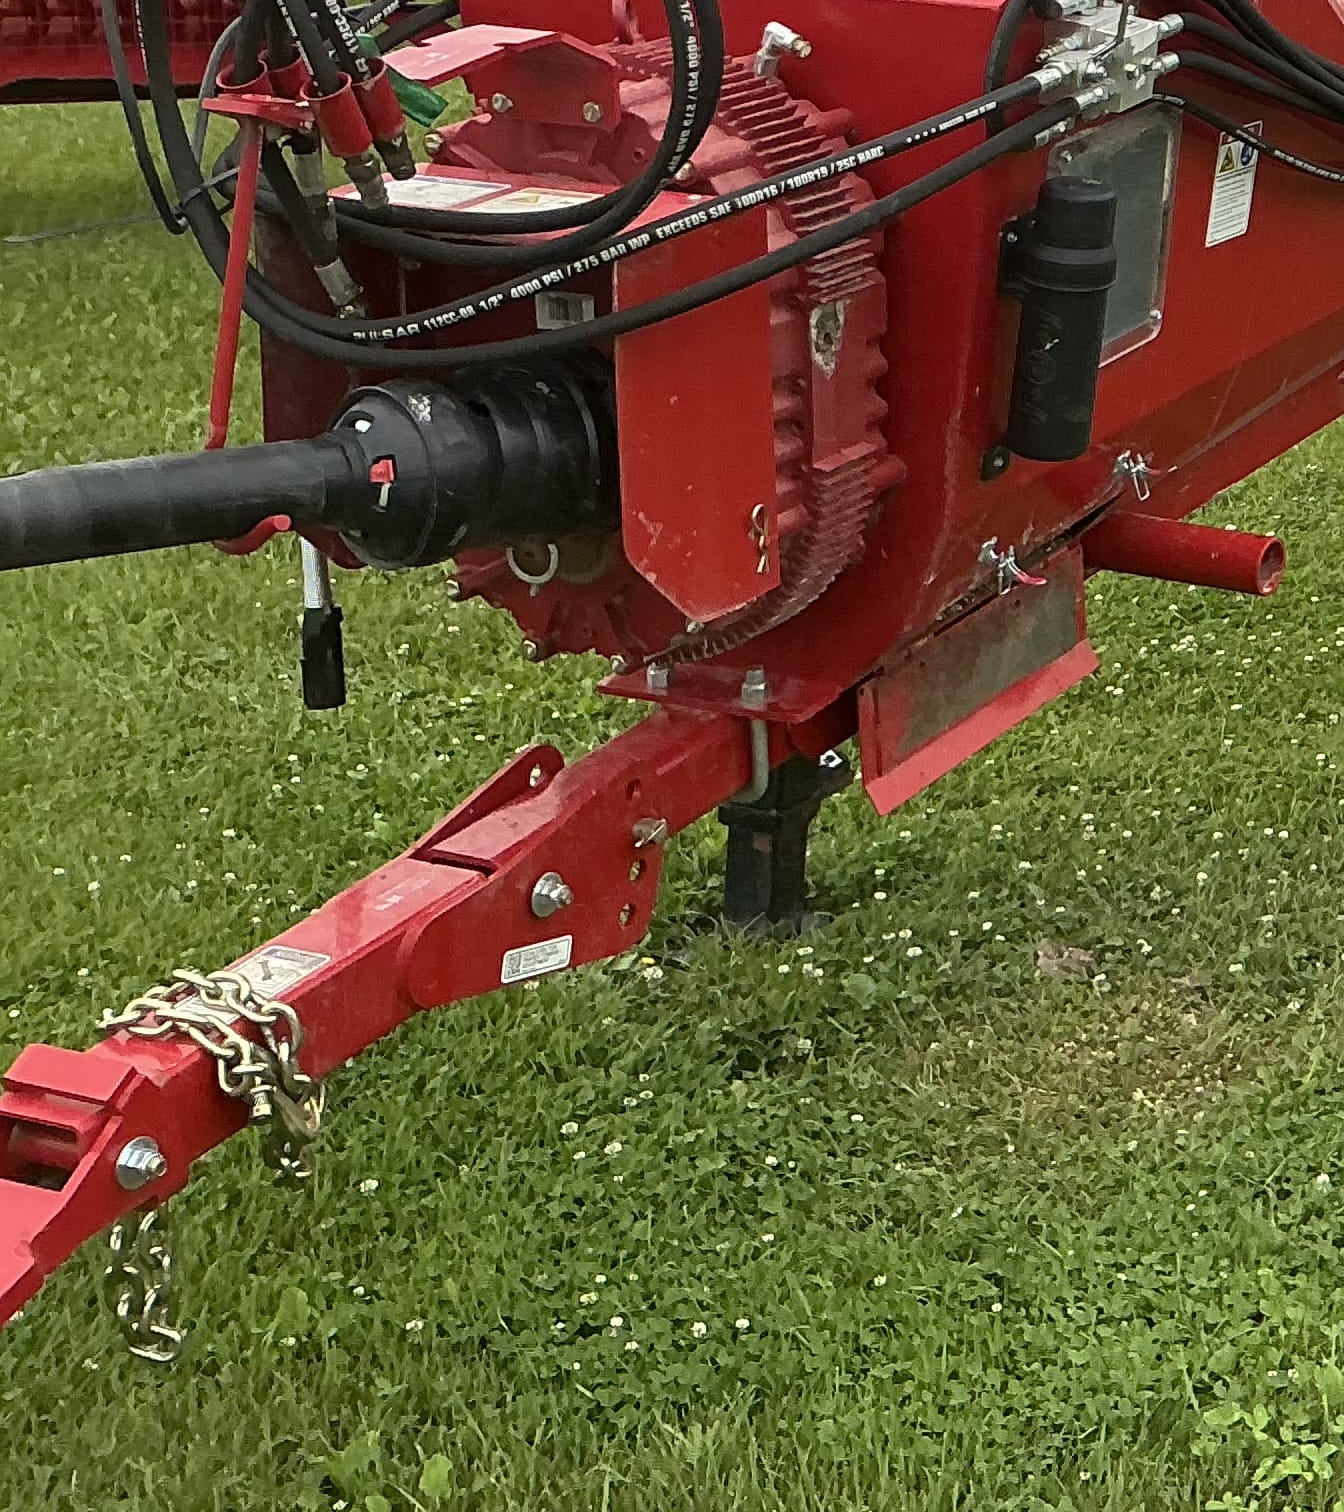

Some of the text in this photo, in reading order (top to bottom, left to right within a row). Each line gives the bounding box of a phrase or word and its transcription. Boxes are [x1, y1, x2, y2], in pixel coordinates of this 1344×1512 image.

[510, 278, 542, 300] 4000
[542, 268, 565, 287] PSI
[573, 253, 599, 273] 275
[601, 243, 627, 262] BAR
[655, 211, 708, 240] EXCEEDS
[710, 200, 733, 220] SAE
